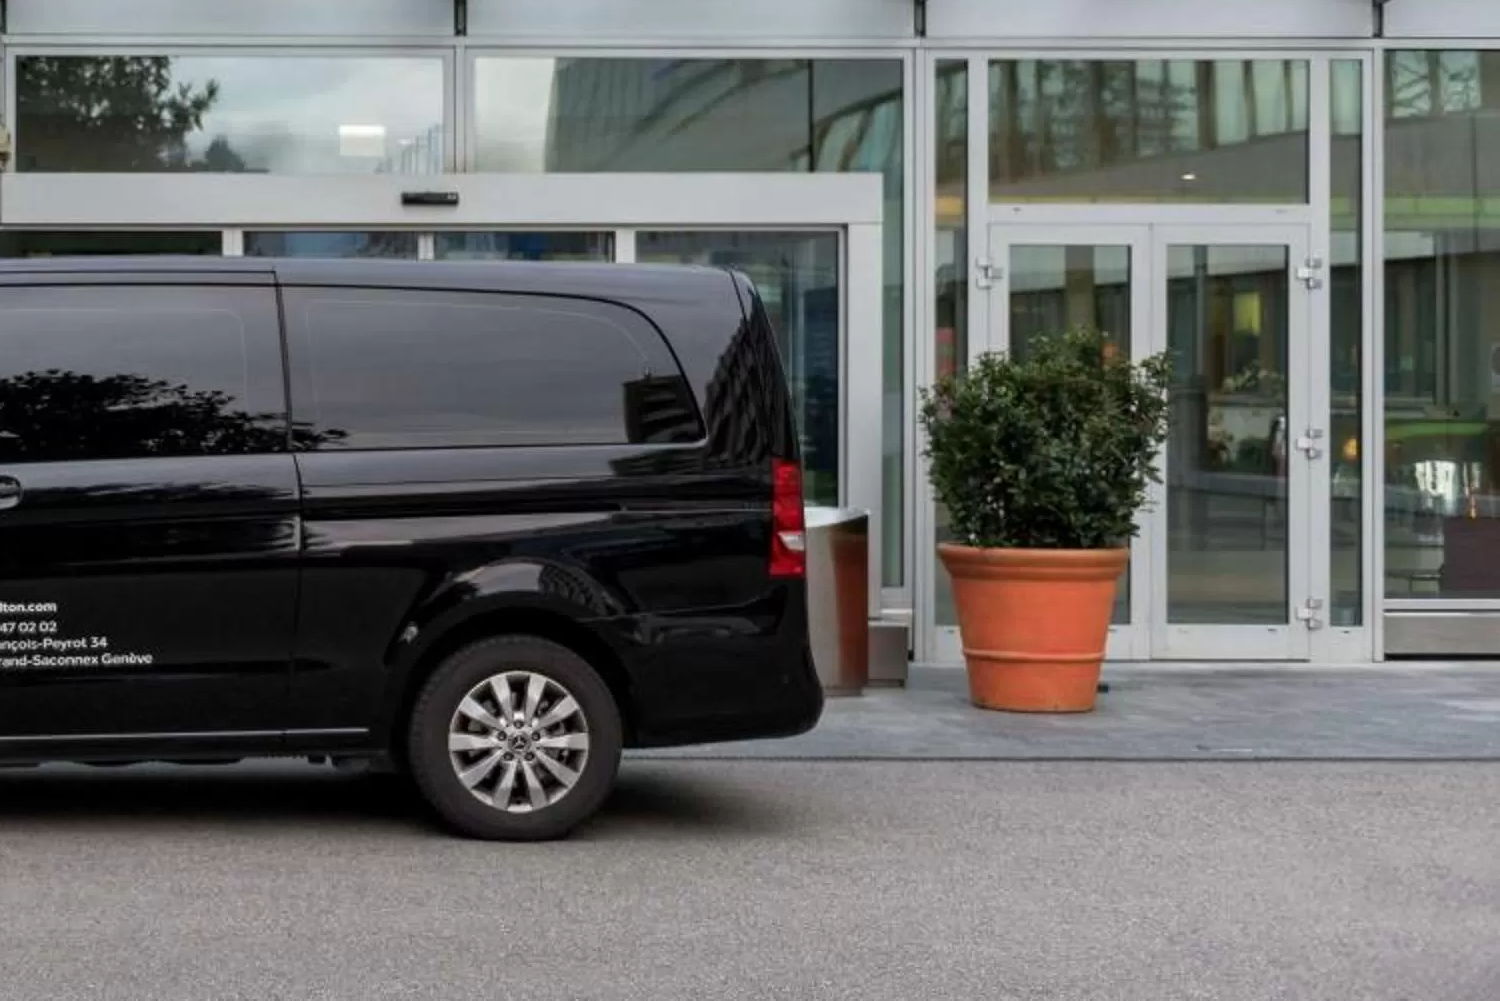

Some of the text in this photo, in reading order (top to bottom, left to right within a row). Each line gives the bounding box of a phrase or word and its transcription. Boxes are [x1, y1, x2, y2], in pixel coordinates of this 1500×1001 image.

[18, 621, 37, 633] 02
[39, 620, 57, 633] 02
[90, 636, 108, 648] 34
